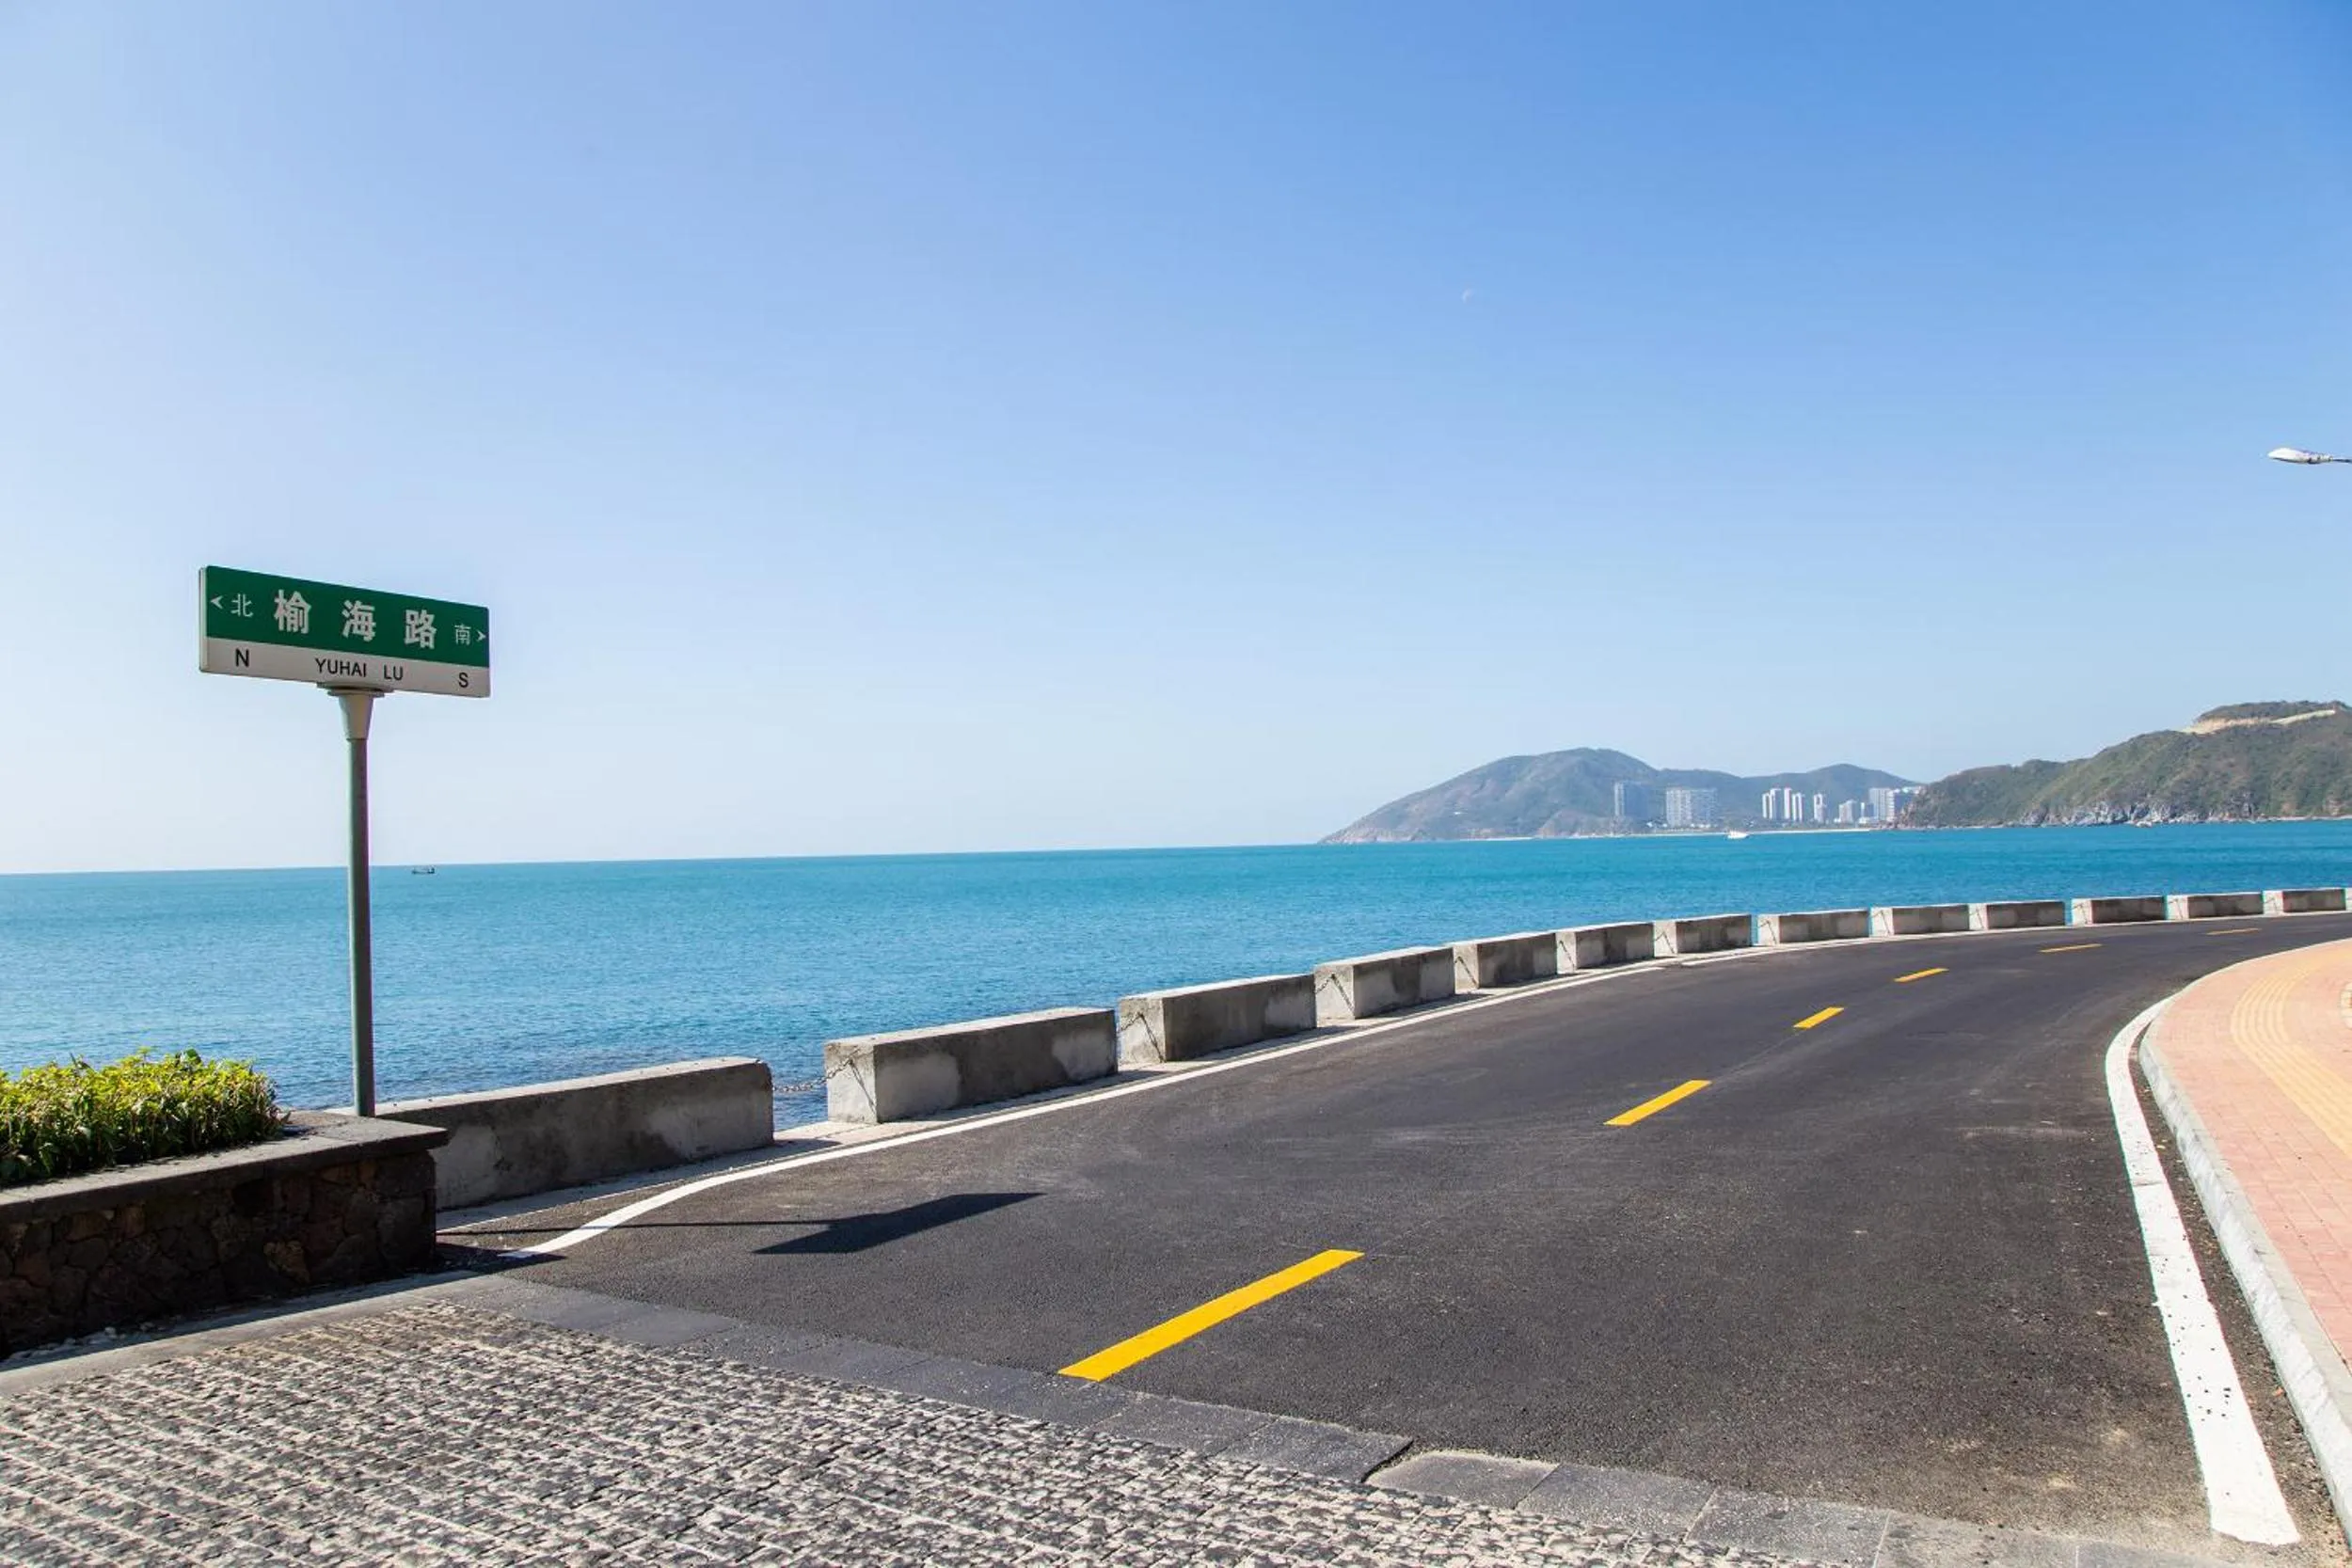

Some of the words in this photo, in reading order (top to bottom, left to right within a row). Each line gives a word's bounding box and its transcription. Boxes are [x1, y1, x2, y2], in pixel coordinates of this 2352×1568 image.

[230, 593, 254, 618] 北
[274, 589, 437, 649] 榆海路
[454, 624, 472, 645] 南
[235, 649, 249, 667] N
[315, 657, 367, 677] YUHAI
[384, 665, 404, 681] LU
[458, 673, 469, 688] S
